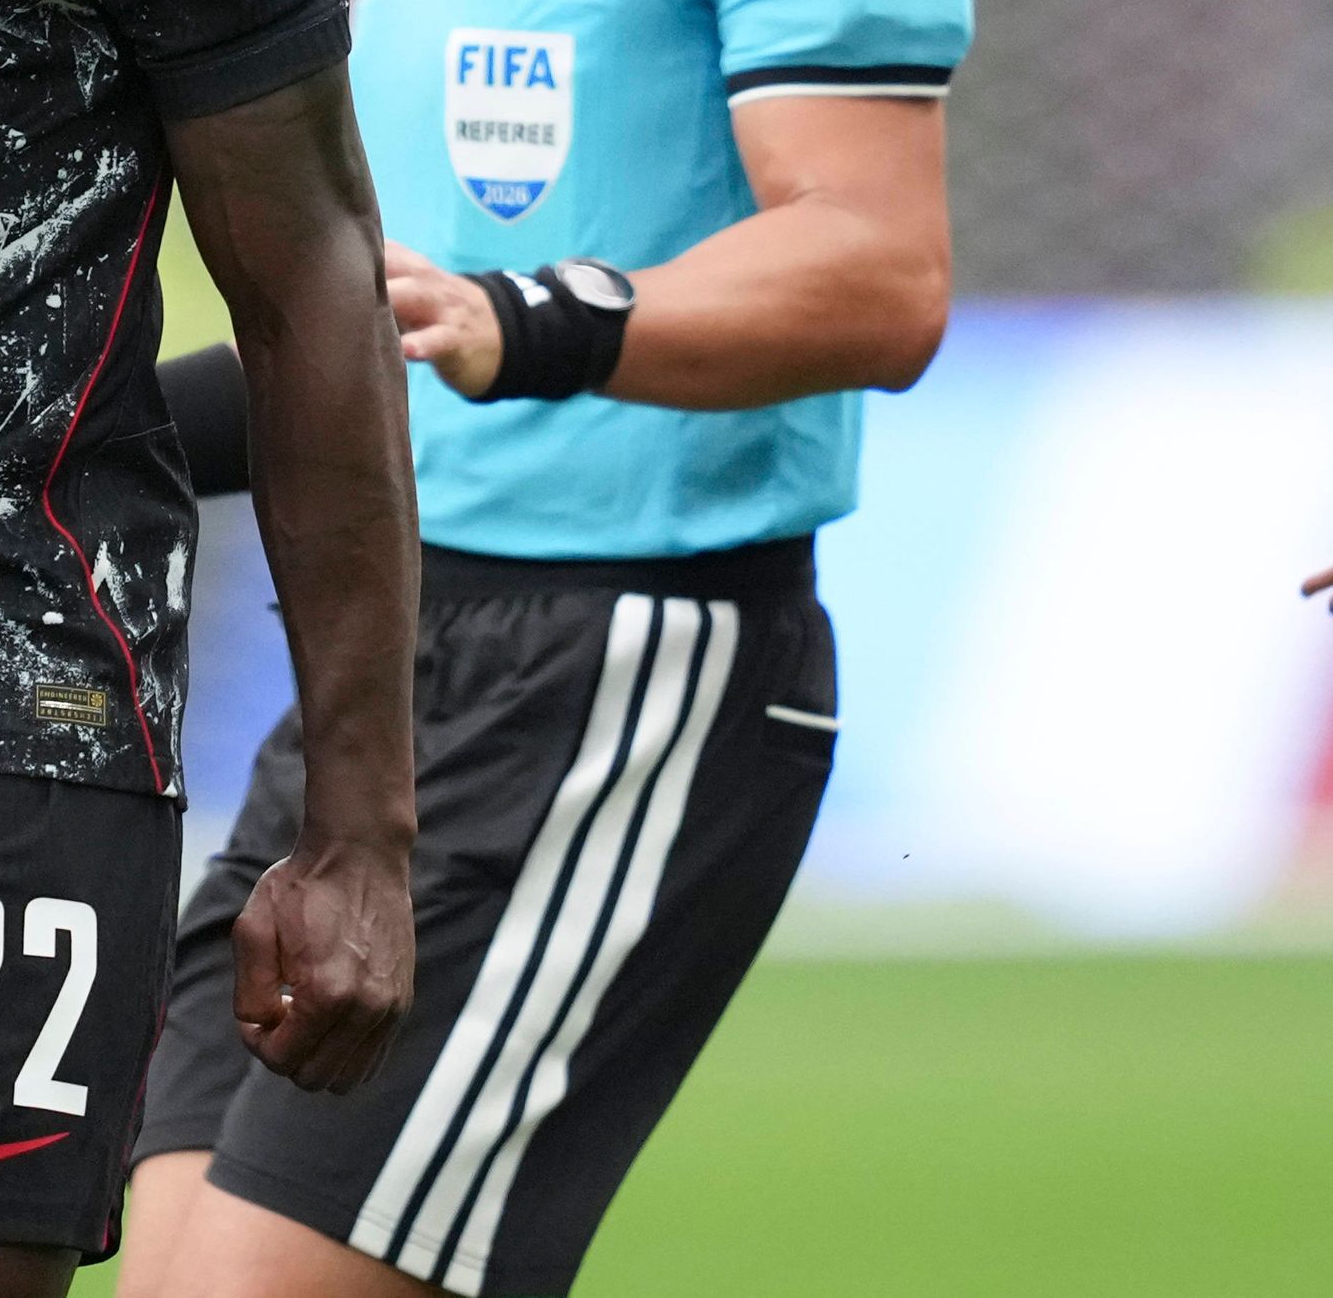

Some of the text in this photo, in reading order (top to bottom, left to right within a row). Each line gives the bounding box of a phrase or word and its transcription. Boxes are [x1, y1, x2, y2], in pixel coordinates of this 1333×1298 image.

[459, 44, 556, 90] FIFA
[456, 119, 555, 146] REFEREE
[485, 184, 529, 204] 2026
